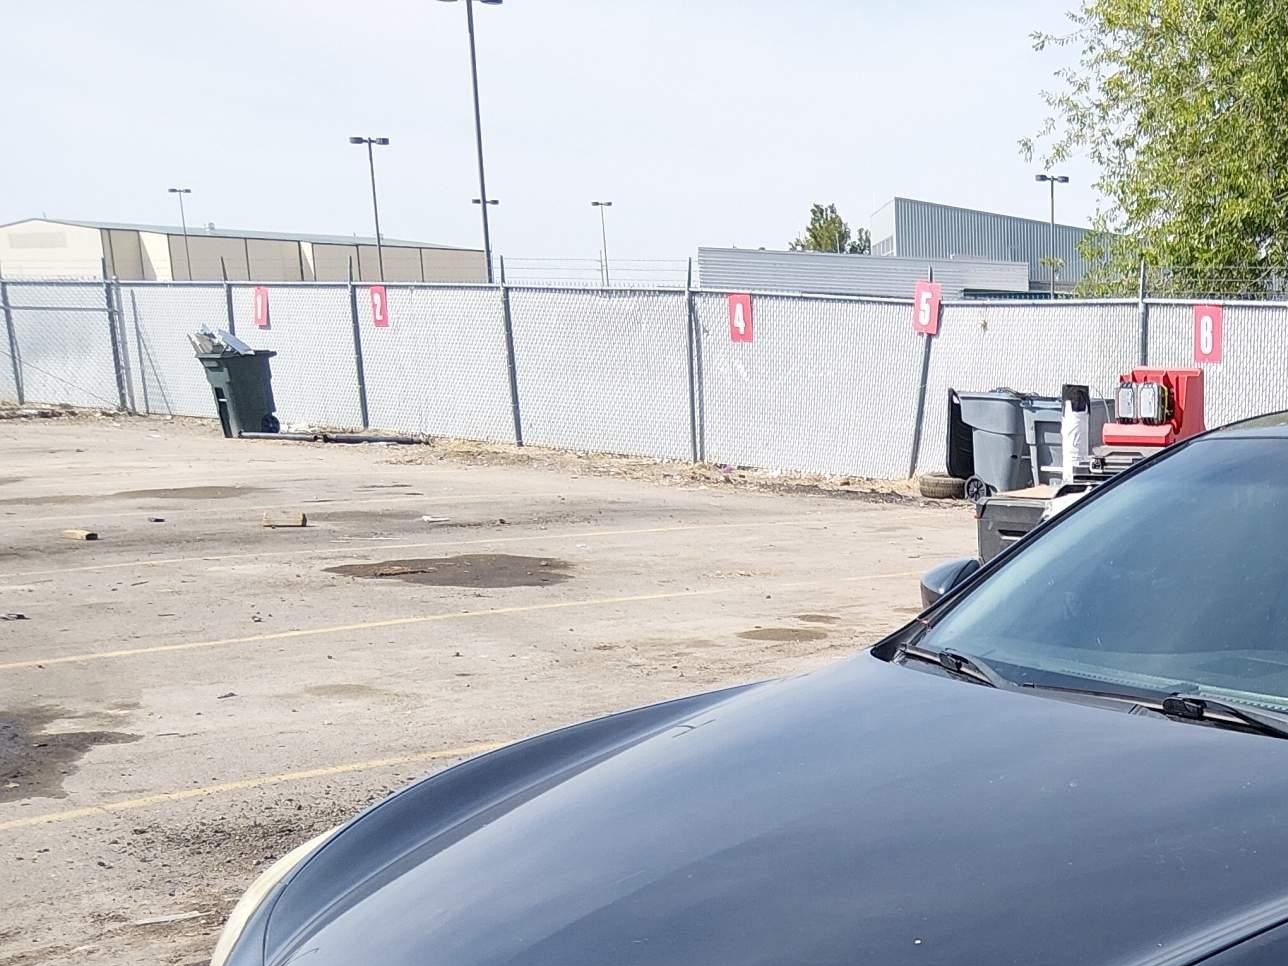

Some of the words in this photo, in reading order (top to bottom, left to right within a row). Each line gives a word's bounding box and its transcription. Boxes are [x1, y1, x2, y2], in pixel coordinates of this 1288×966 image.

[255, 293, 262, 320] 1
[373, 293, 383, 320] 2
[733, 303, 746, 335] 4
[918, 291, 932, 326] 5
